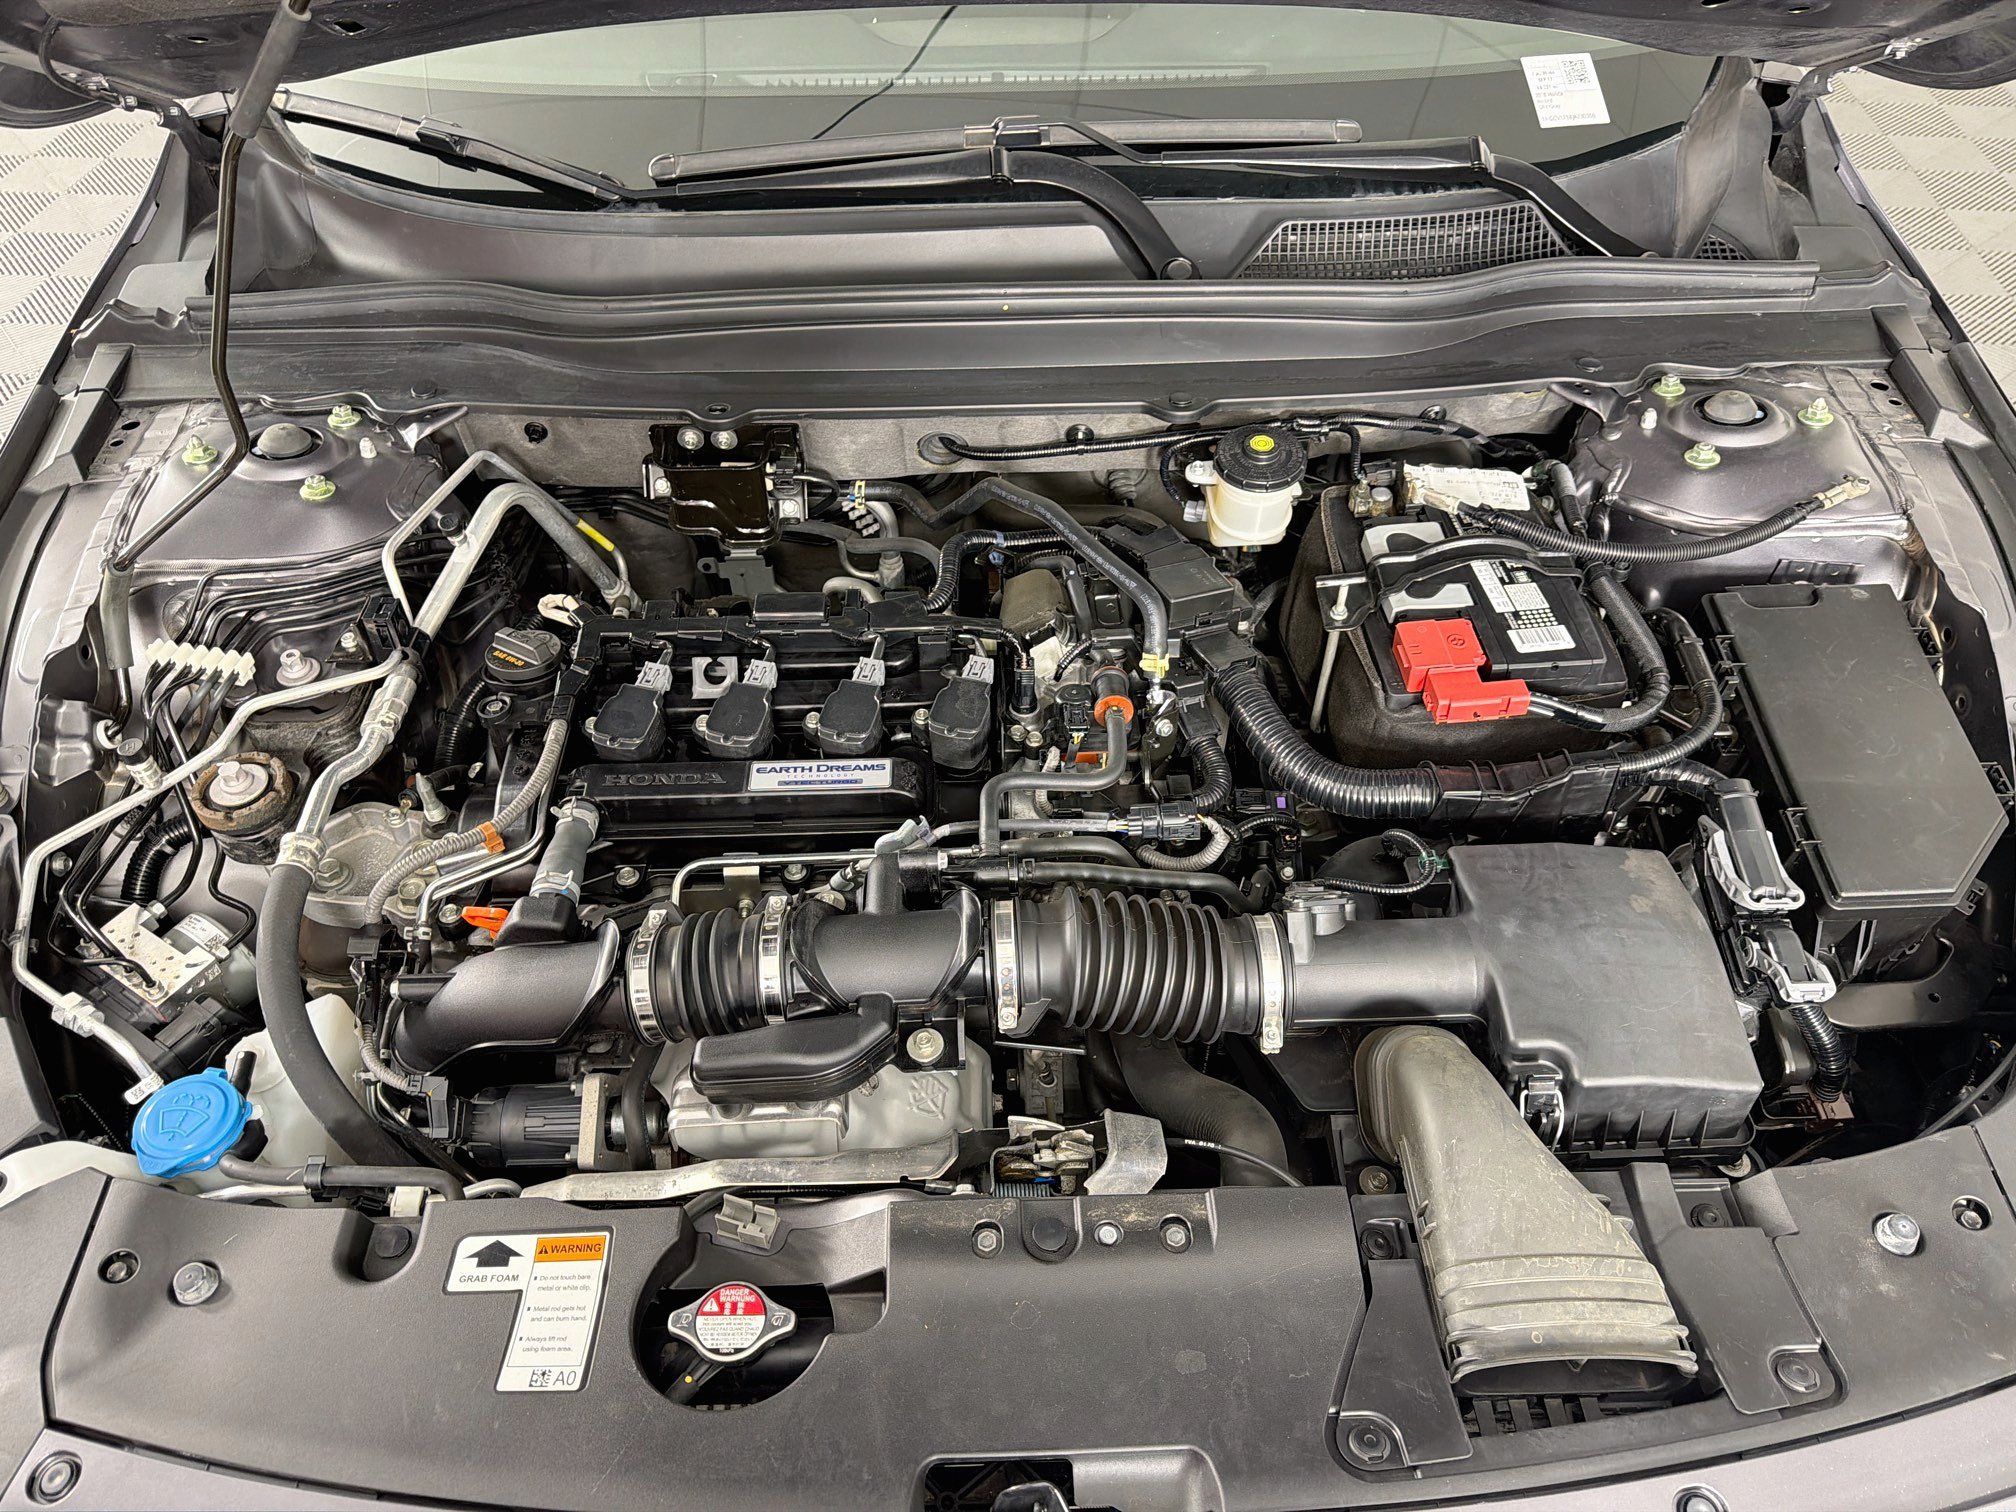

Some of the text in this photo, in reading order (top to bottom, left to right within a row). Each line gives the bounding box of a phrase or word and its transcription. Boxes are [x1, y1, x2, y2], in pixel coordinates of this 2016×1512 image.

[492, 650, 507, 660] SAE
[756, 763, 886, 774] EARTH DREAMS
[602, 772, 727, 786] HONDA
[551, 1243, 602, 1254] WARNING
[459, 1274, 520, 1283] GRAB FOAM
[720, 1288, 749, 1296] DANGER
